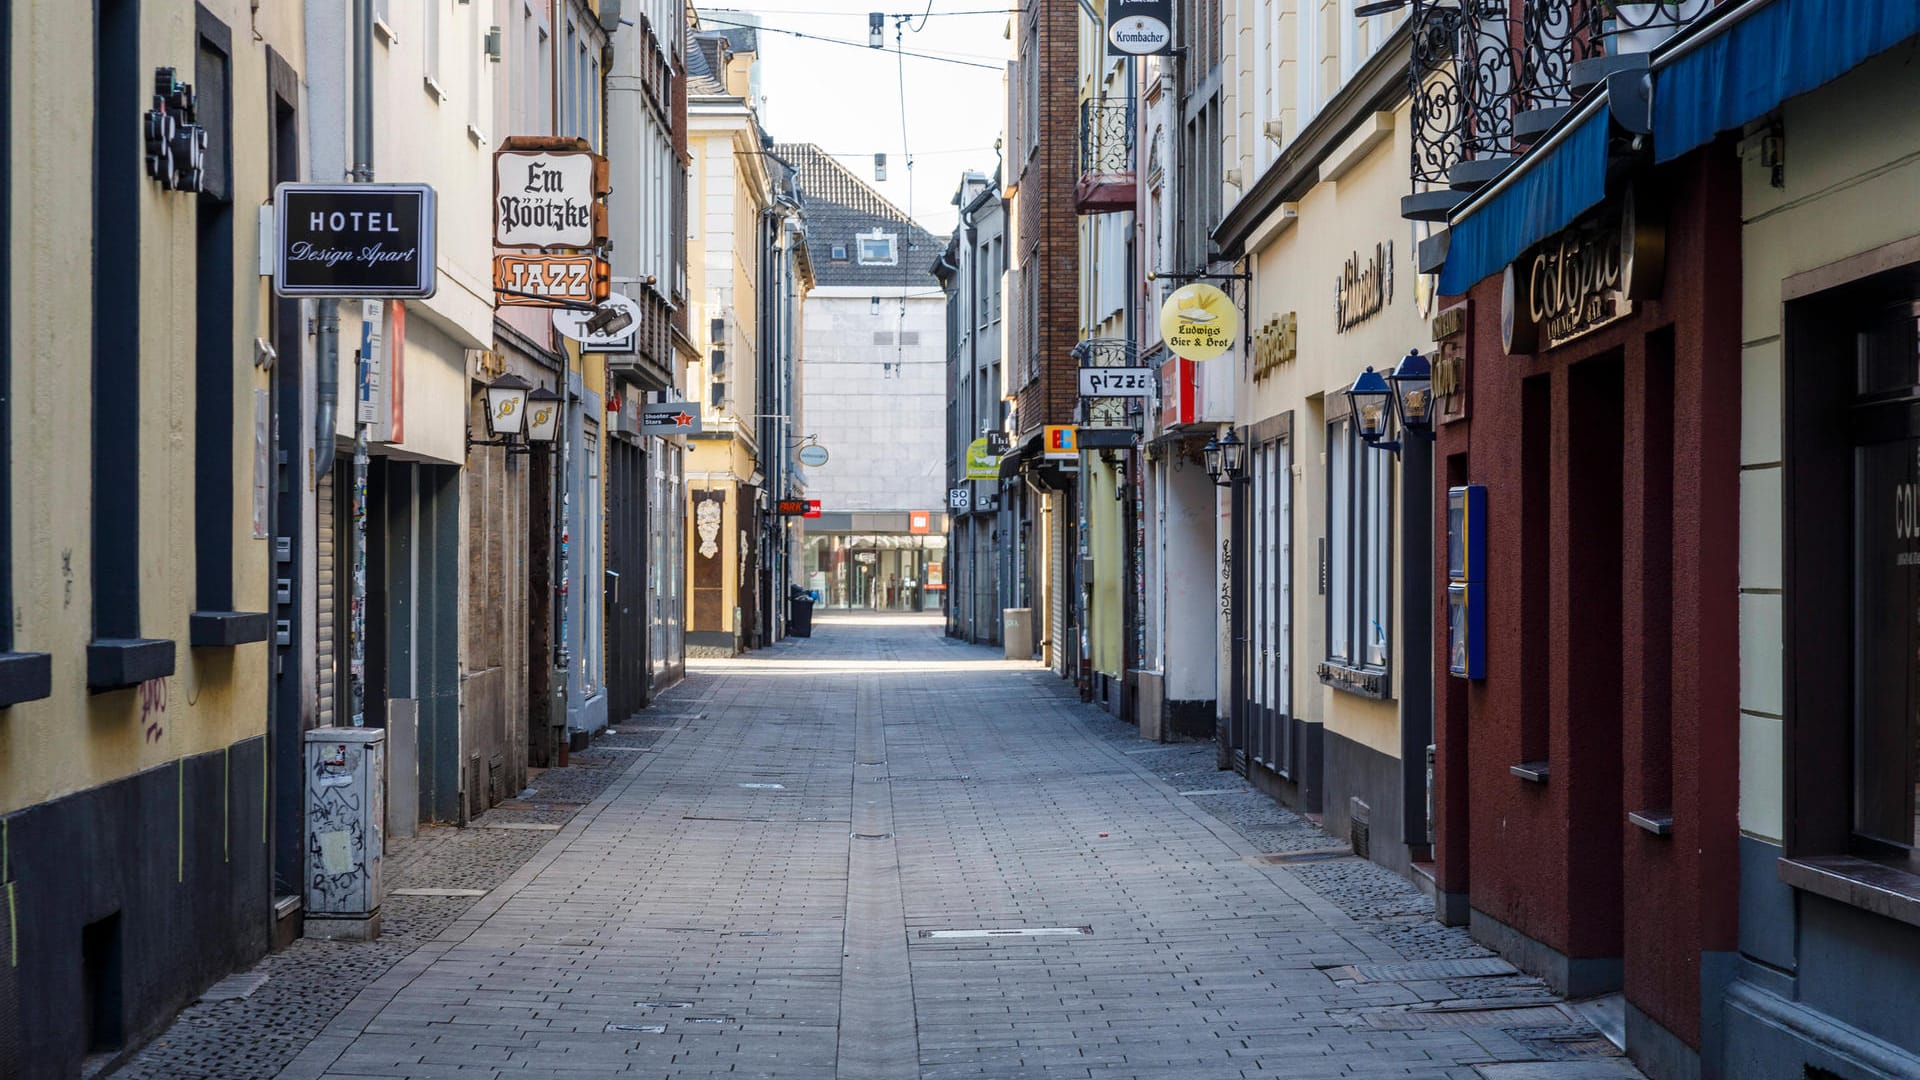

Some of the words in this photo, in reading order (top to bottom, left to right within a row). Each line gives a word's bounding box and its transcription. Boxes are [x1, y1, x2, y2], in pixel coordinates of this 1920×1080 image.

[1116, 31, 1164, 42] Krombacher
[524, 161, 564, 193] Em
[310, 211, 400, 232] HOTEL
[500, 195, 589, 235] Pöötzke
[288, 241, 353, 268] Design
[356, 242, 415, 268] Apart
[507, 263, 588, 296] JAZZ
[1178, 324, 1221, 337] Ludwigs
[1170, 336, 1191, 347] Bier
[1194, 338, 1202, 347] &
[1206, 337, 1228, 347] Brot
[951, 490, 968, 498] SO
[952, 499, 968, 507] LO
